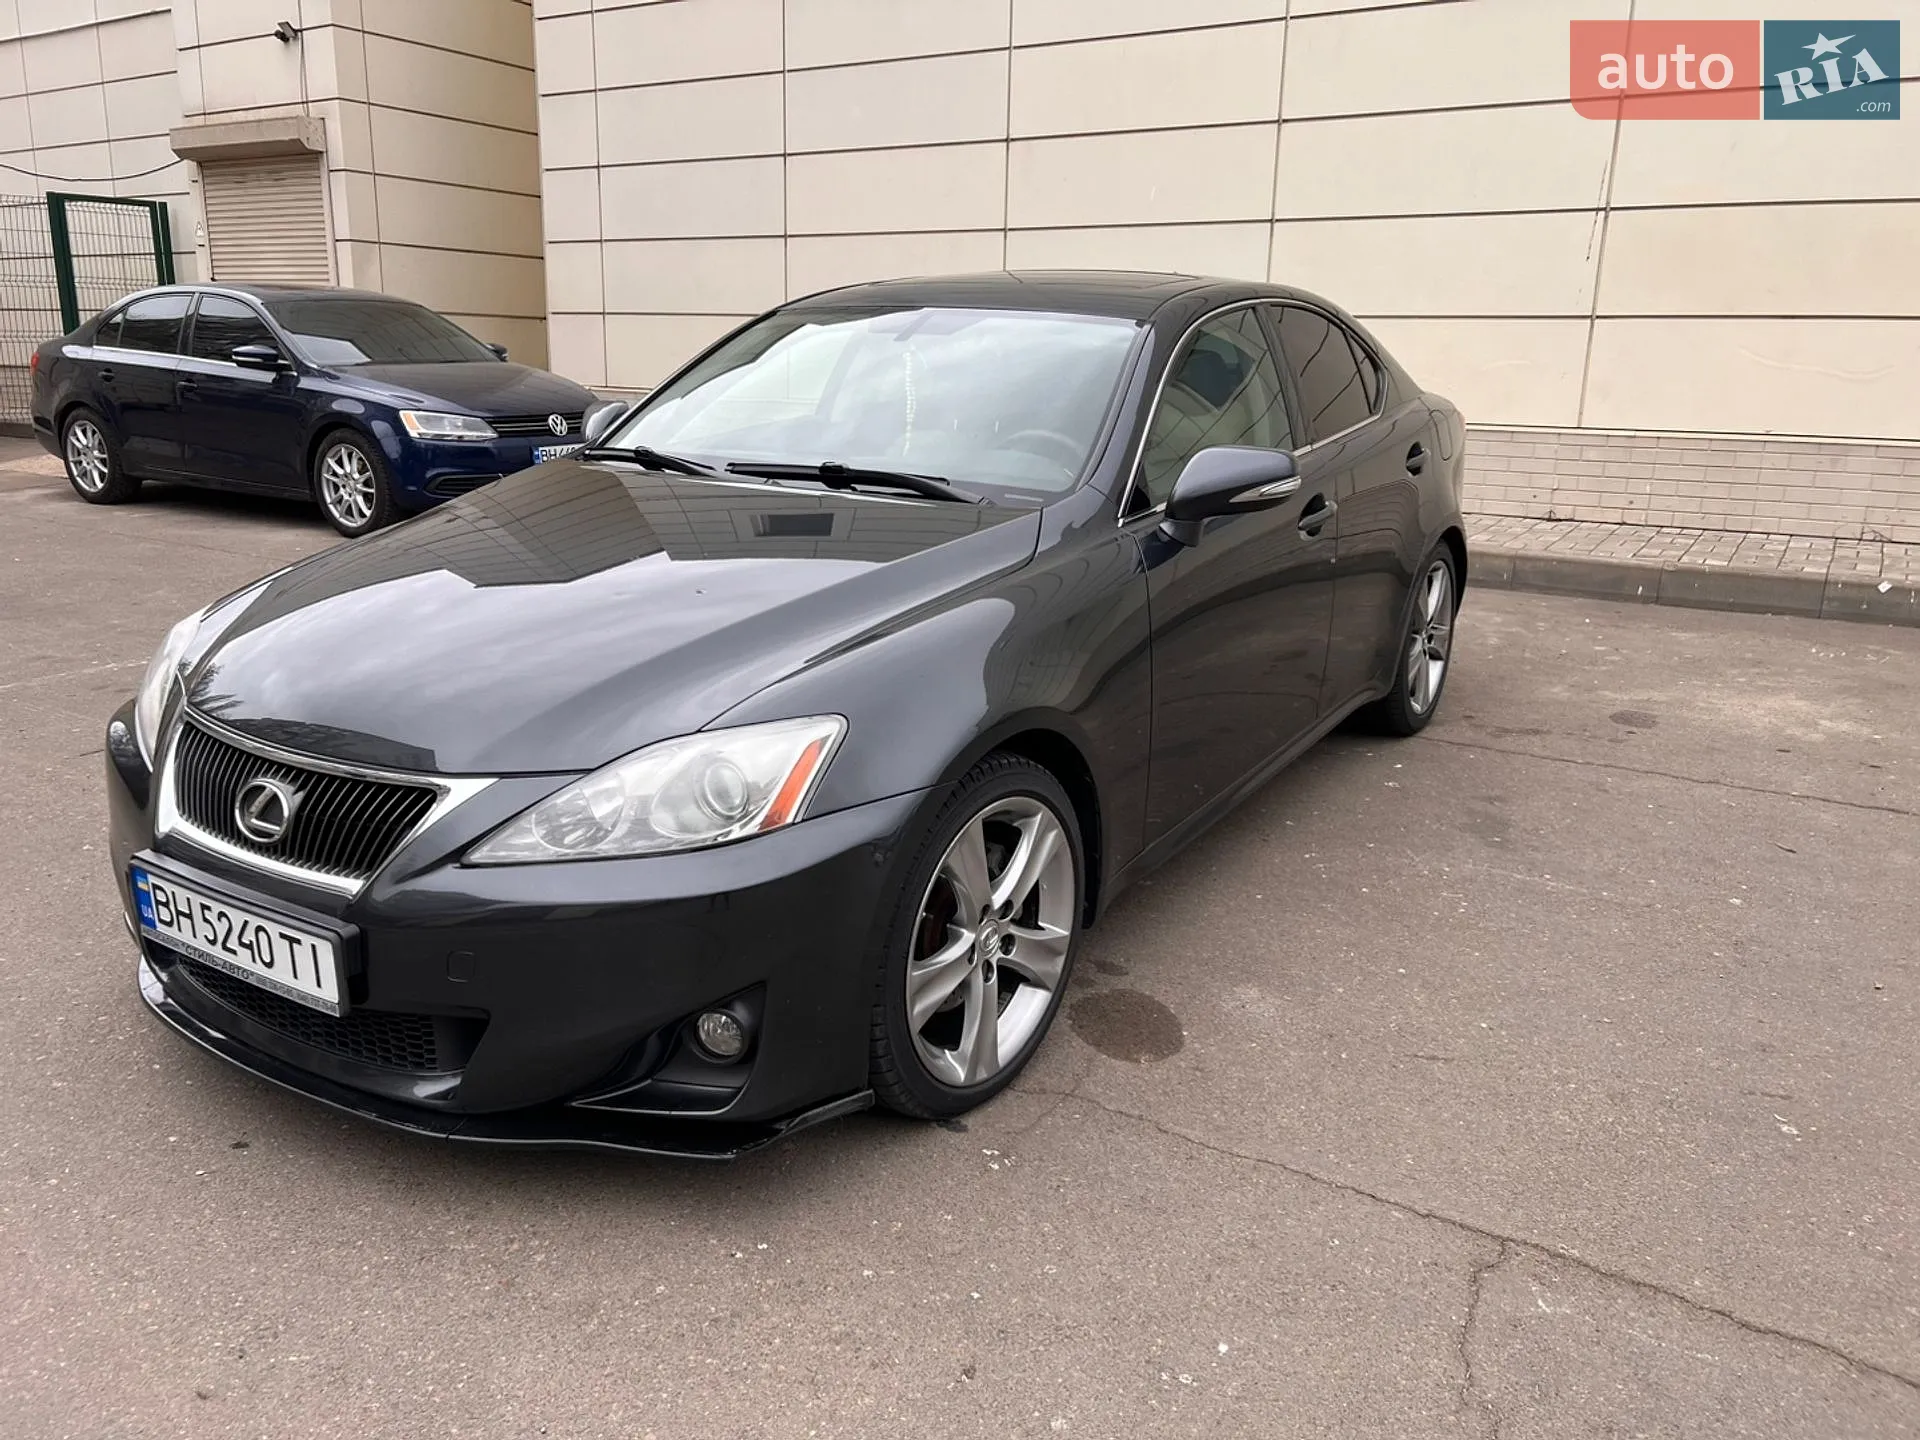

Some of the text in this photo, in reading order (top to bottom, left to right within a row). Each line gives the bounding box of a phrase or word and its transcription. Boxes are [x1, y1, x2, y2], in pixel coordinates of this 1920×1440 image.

[141, 904, 154, 920] UA
[151, 882, 197, 939] BH
[199, 901, 275, 969] 5240
[278, 931, 322, 988] TI
